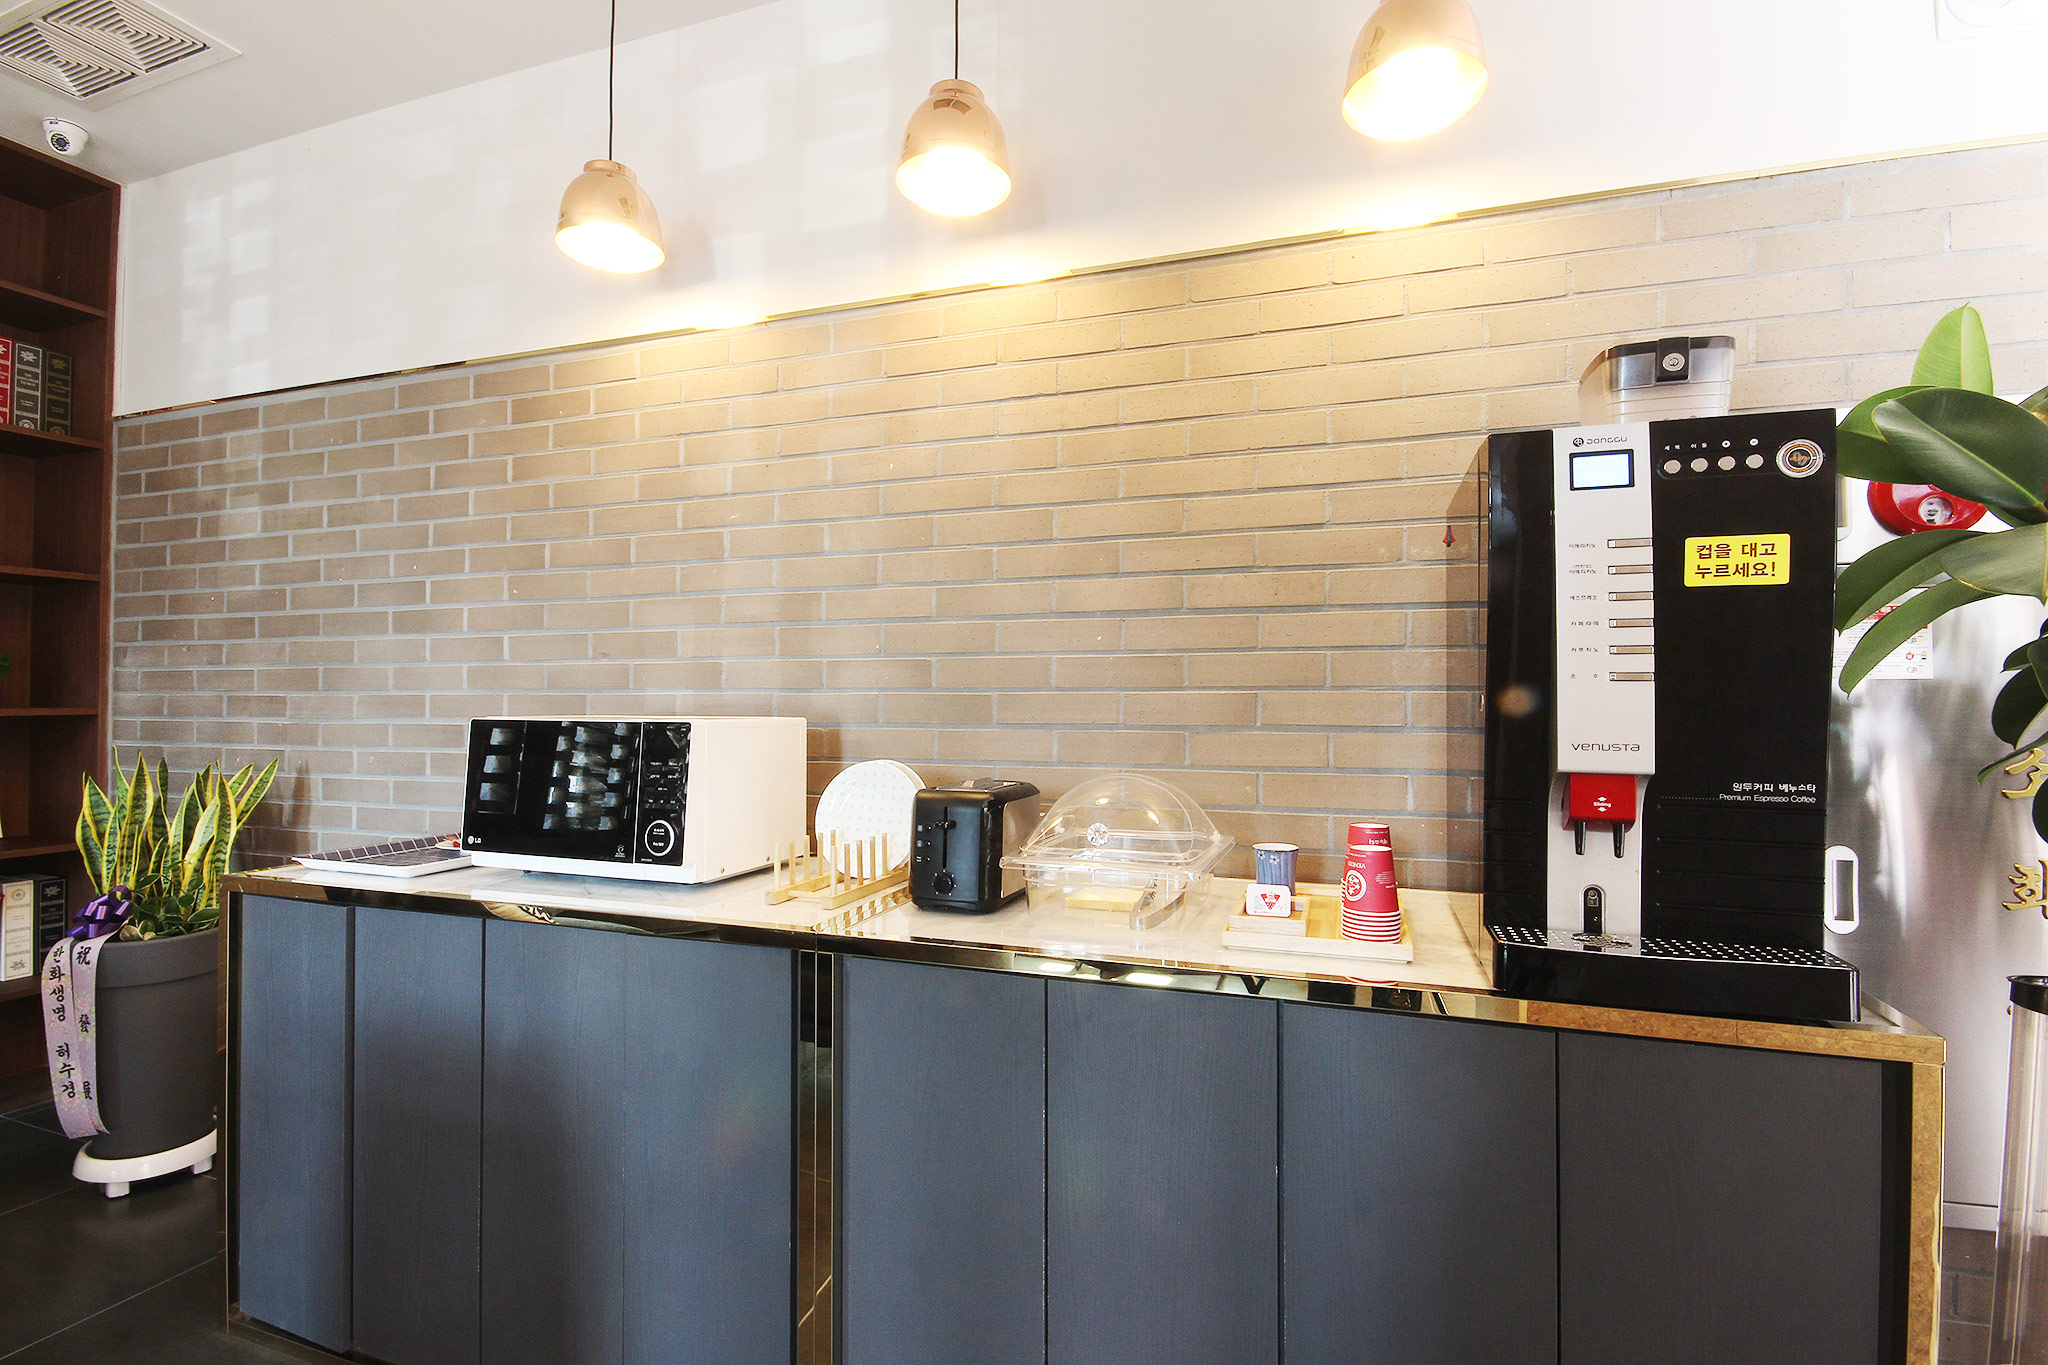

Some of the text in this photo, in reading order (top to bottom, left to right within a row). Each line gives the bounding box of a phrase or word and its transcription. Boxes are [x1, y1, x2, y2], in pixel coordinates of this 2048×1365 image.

[1696, 542, 1777, 560] 컵을 대고
[1694, 561, 1776, 579] 누르세요!
[1732, 782, 1774, 792] 원두커피
[1719, 793, 1817, 804] Premium Espresso Coffee
[49, 945, 66, 1022] 한화생명
[55, 1042, 76, 1099] 허수경
